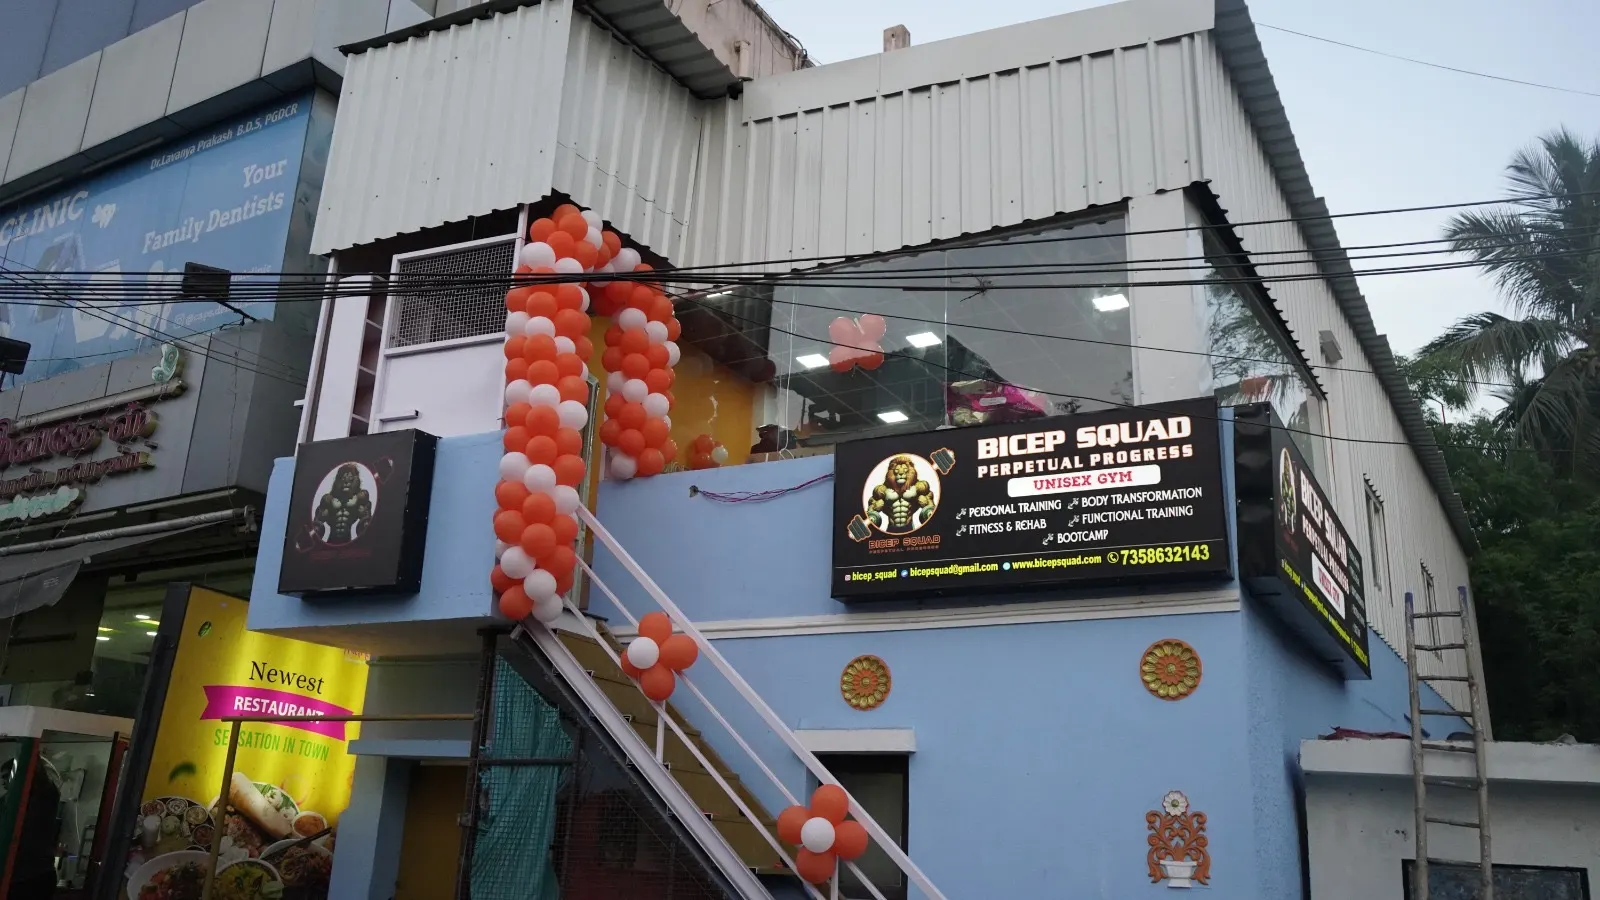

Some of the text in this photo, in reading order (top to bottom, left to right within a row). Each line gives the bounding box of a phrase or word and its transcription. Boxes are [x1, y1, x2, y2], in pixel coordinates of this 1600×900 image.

[150, 145, 196, 170] Dr.Lavanya
[197, 128, 233, 152] Prakash
[265, 103, 298, 125] PGDCR
[242, 159, 288, 188] Your
[0, 190, 89, 247] CLINIC
[142, 191, 285, 254] Family Dentists
[977, 416, 1192, 460] BICEP SQUAD
[977, 444, 1194, 478] PERPETUAL PROGRESS
[1033, 470, 1133, 490] UNISEX GYM
[968, 500, 1062, 518] PERSONAL TRAINING
[1081, 487, 1203, 508] BODY TRANSFORMATION
[969, 519, 1047, 535] FITNESS & REHAB
[1082, 505, 1194, 524] FUNCTIONAL TRAINING
[868, 534, 941, 549] BICEP SQUAD
[1057, 529, 1109, 544] BOOTCAMP
[852, 544, 1210, 582] bicep_squad bicepsquad@gmail.com www.bicepsquad.com 7358632143
[249, 661, 324, 694] Newest
[233, 696, 324, 724] RESTAURANT
[214, 728, 330, 761] SESATION IN TOWN
